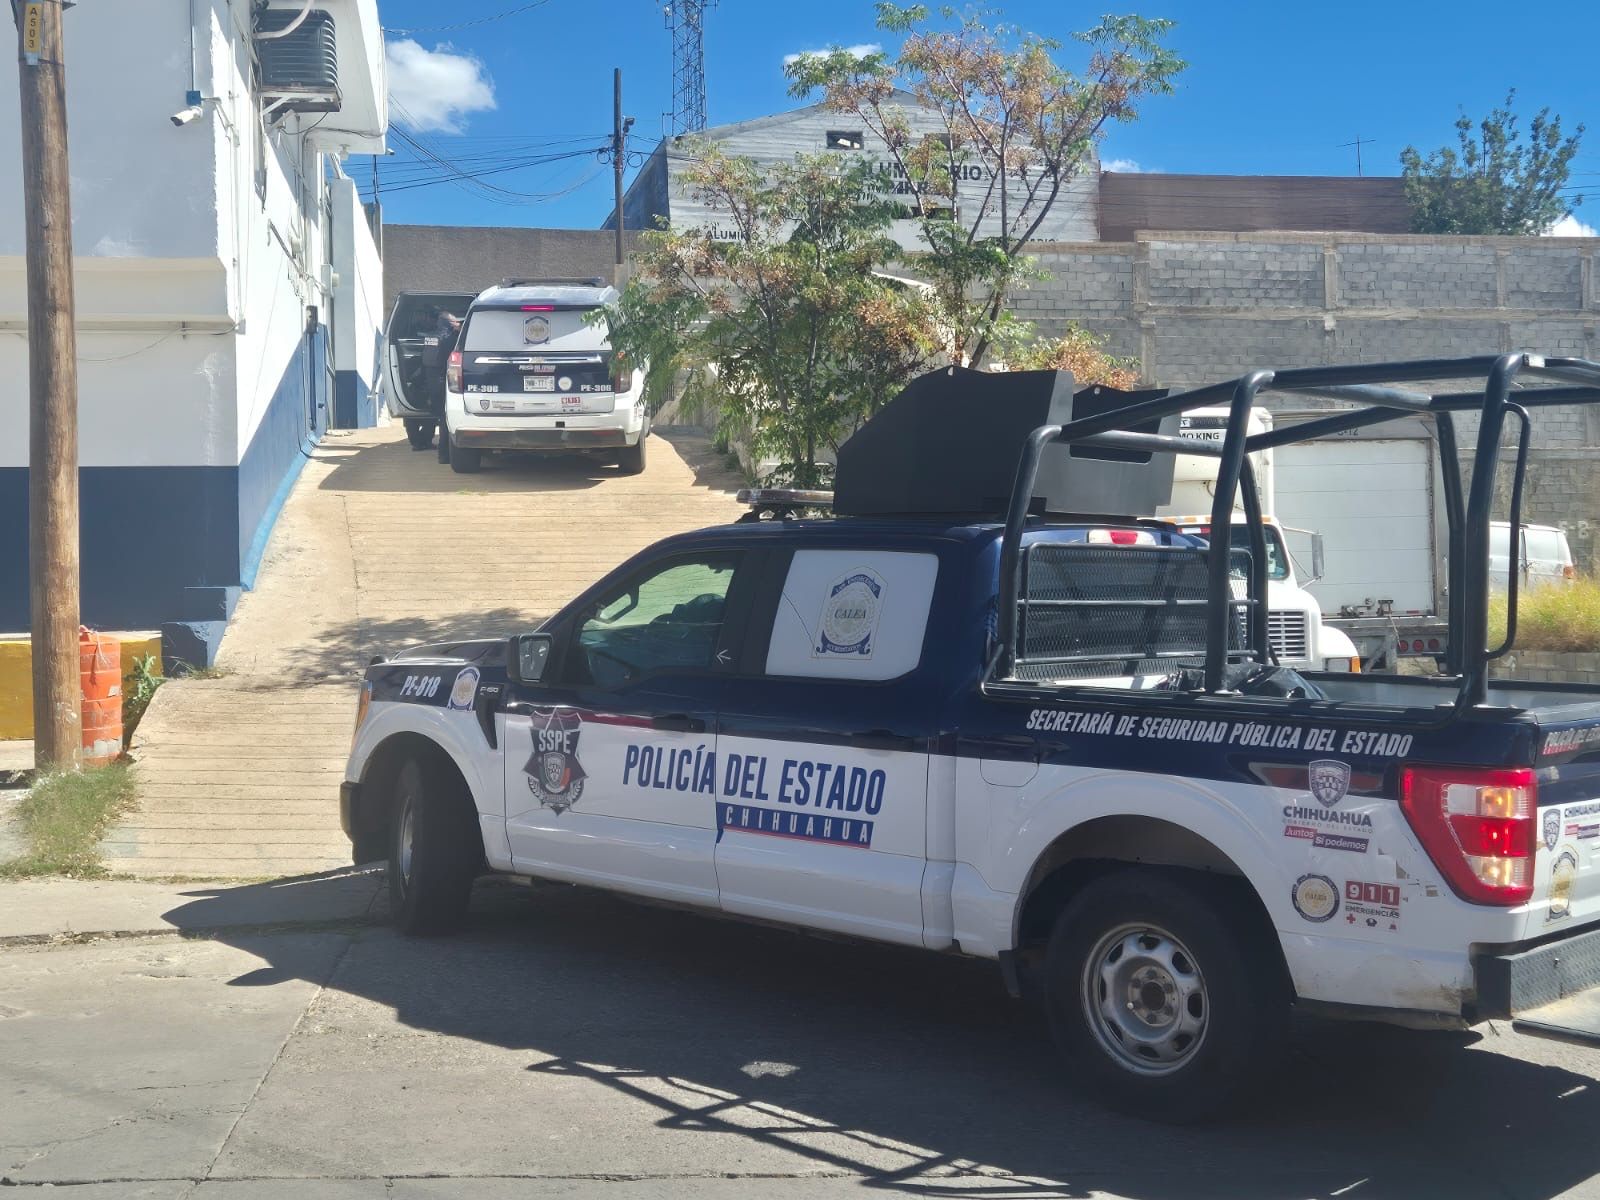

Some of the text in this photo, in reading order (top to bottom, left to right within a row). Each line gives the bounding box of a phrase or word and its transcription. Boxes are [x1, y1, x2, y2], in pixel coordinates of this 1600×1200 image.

[1195, 432, 1220, 441] KING
[833, 608, 867, 619] CALEA
[538, 729, 572, 754] SSPE
[1026, 708, 1413, 758] SECRETARÍA DE SEGURIDAD PÚBLICA DEL ESTADO
[622, 744, 887, 816] POLICÍA DEL ESTADO
[725, 805, 869, 843] CHIHUAHUA
[1283, 805, 1372, 827] CHIHUAHUA
[1286, 826, 1315, 839] Juntos
[1324, 837, 1367, 851] podemos
[1347, 883, 1396, 904] 911
[1345, 905, 1400, 919] EMERGENCIAS
